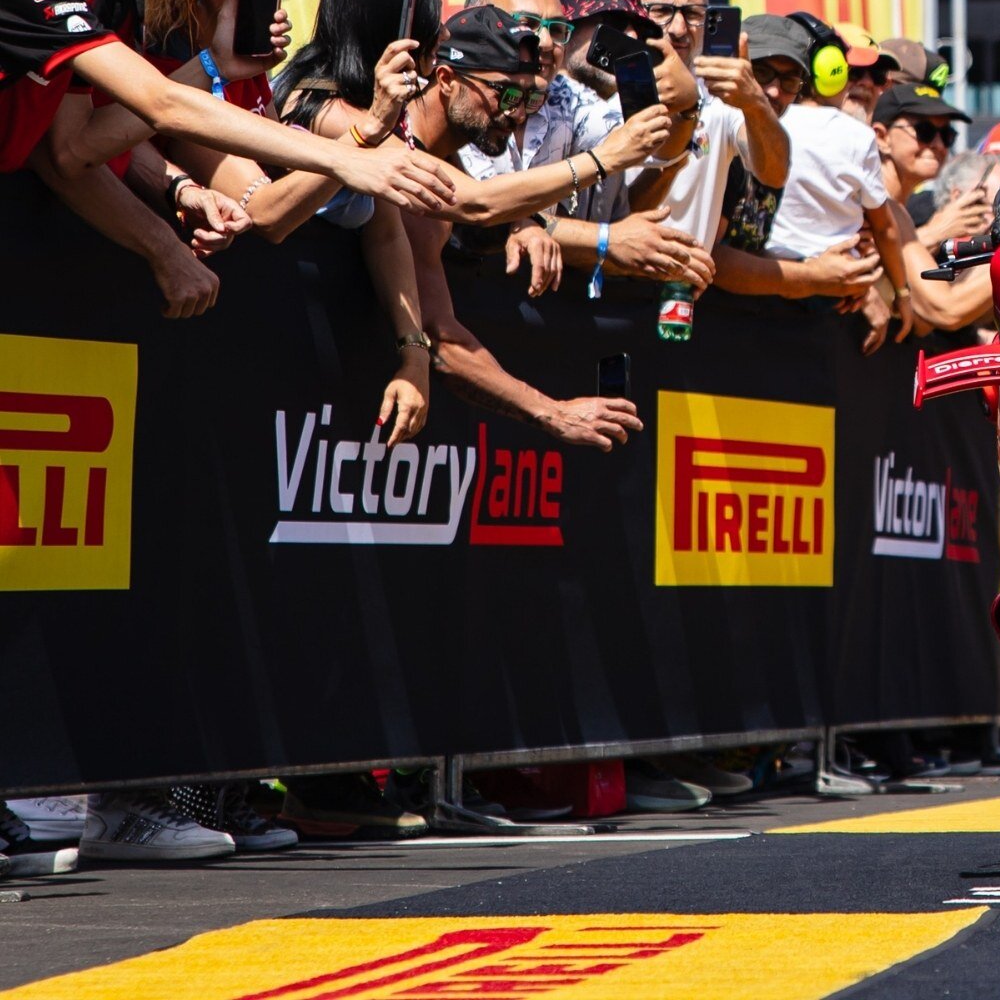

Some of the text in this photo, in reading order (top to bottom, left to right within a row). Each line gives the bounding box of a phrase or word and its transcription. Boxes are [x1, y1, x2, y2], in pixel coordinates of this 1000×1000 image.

[269, 404, 475, 545] Victory
[673, 435, 826, 555] PIRELLI
[872, 451, 946, 559] Victory
